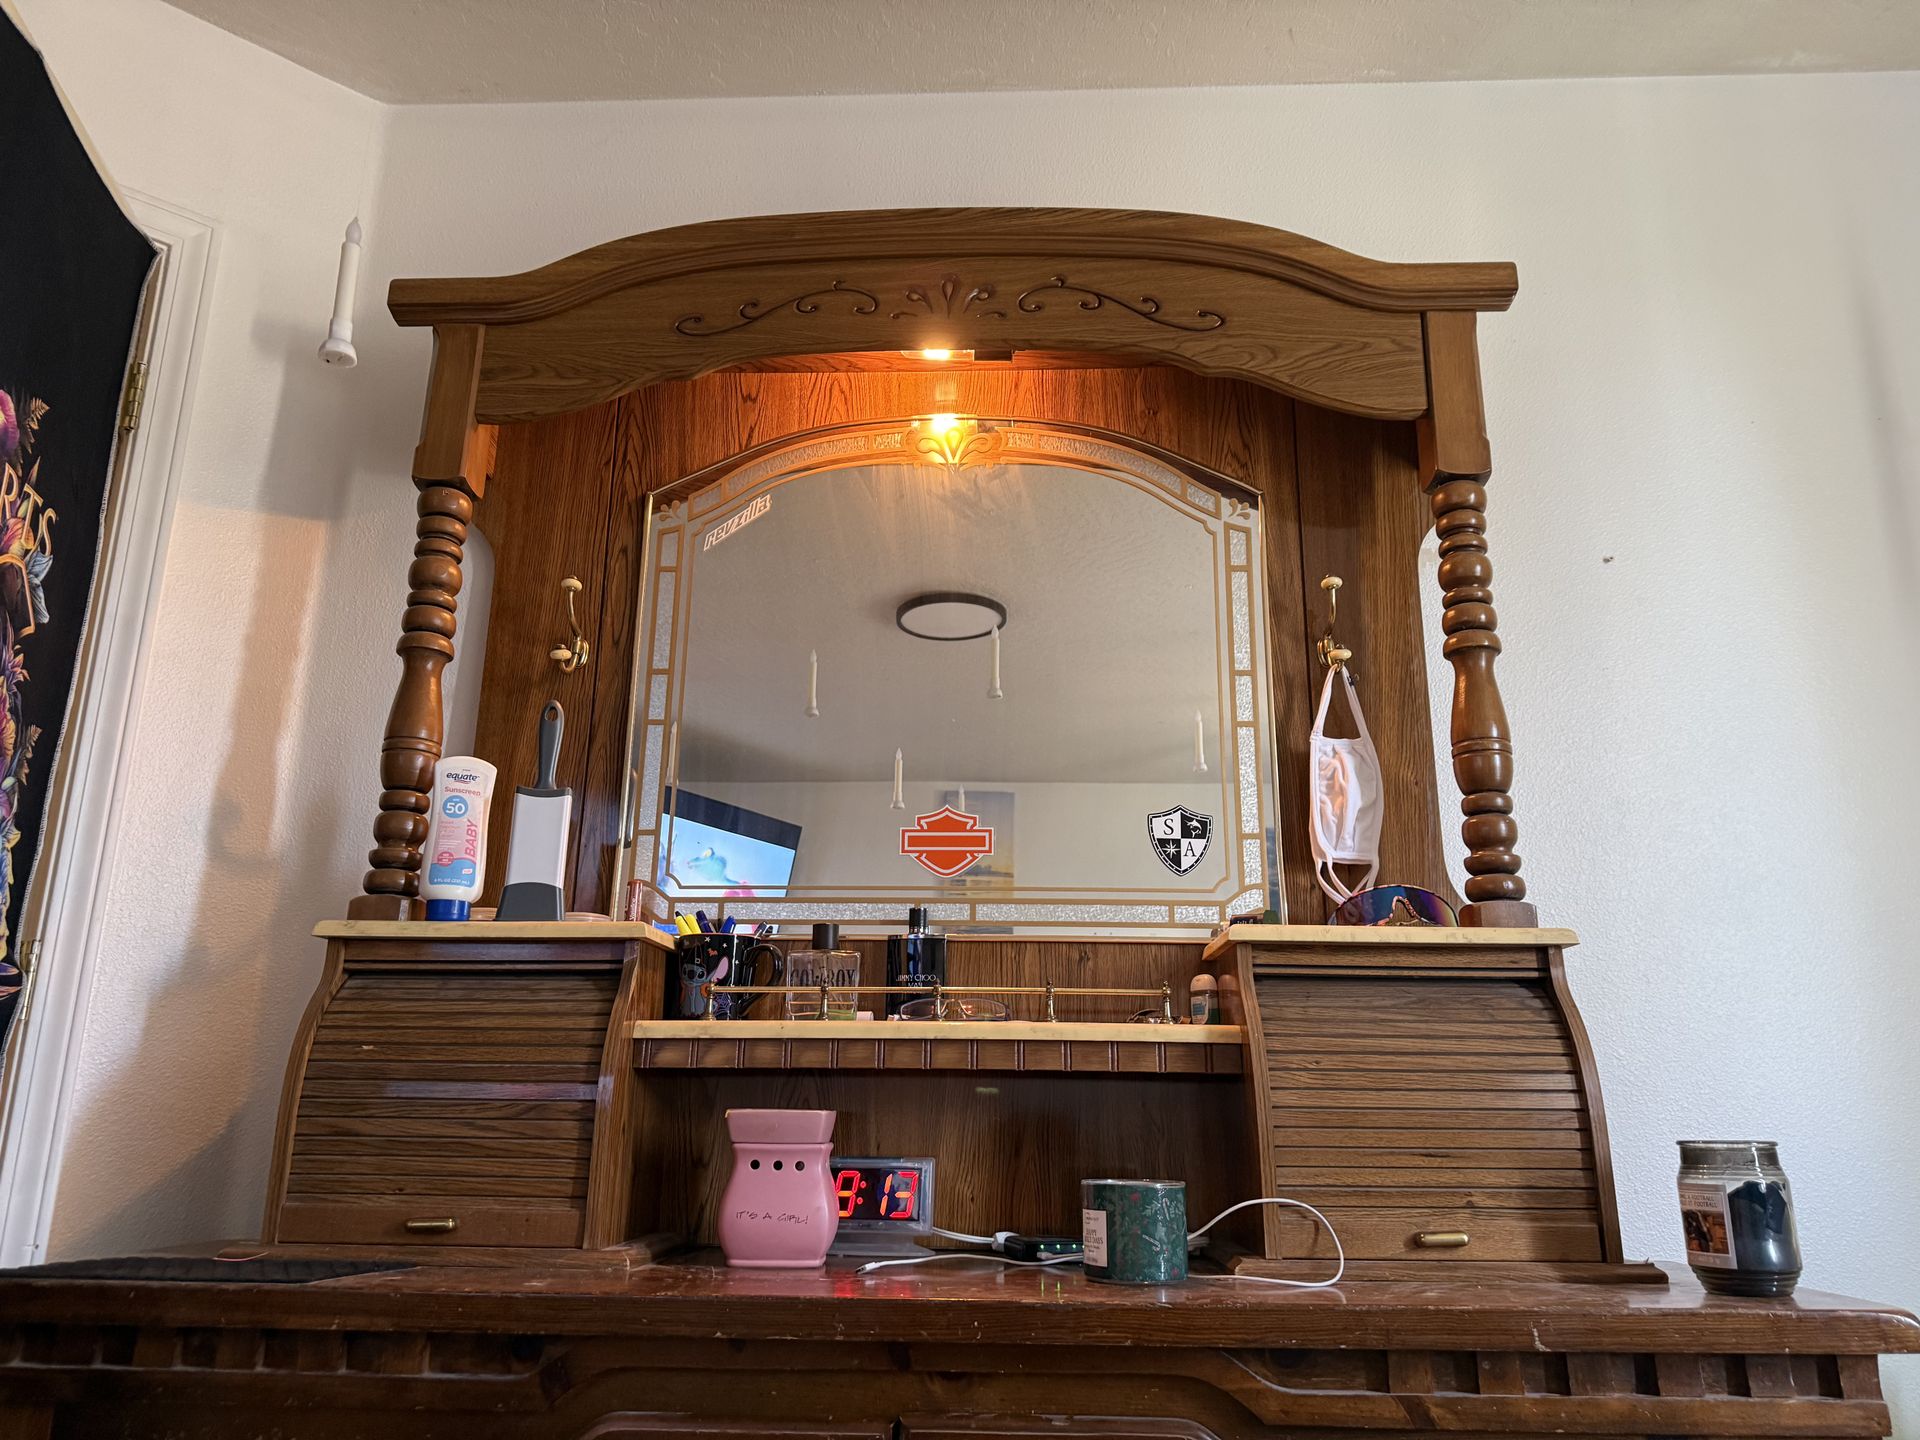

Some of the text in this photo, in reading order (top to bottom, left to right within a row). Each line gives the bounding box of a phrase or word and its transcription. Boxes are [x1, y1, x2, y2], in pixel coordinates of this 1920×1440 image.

[446, 772, 479, 782] equate
[444, 786, 481, 796] Sunscreen
[445, 802, 466, 814] 50
[1163, 818, 1174, 836] S
[464, 819, 478, 858] BABY
[1183, 840, 1197, 857] A
[896, 973, 937, 982] JIMMY CHOO
[736, 1210, 808, 1225] IT'S A GIRL!
